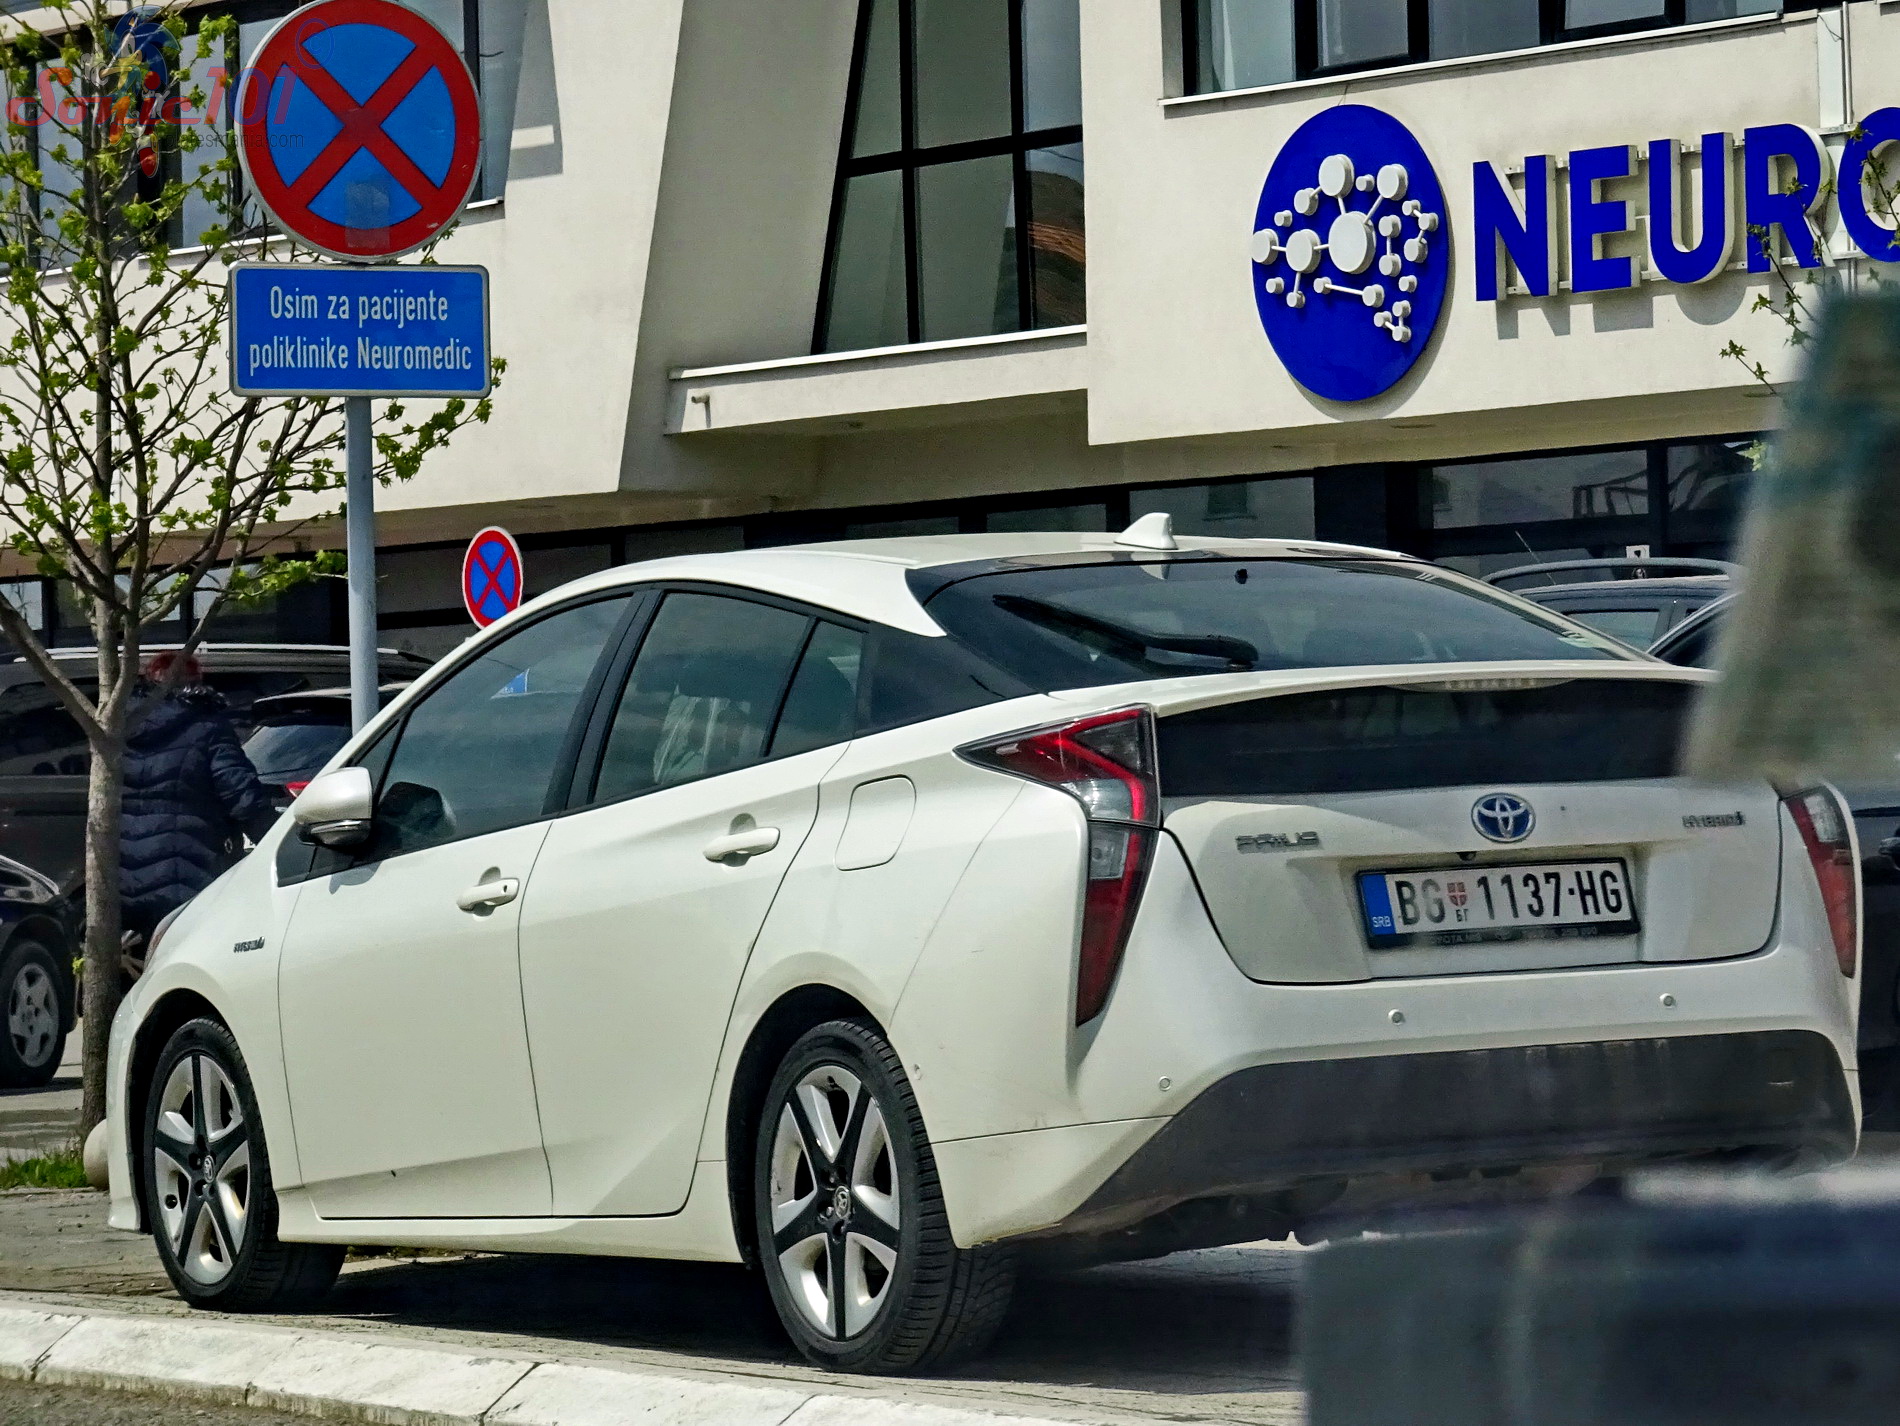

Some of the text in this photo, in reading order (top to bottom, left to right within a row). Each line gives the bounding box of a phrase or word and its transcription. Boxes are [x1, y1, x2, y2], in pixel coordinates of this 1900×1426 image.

[270, 285, 448, 329] Osim za pacijente
[249, 335, 471, 376] poliklinike Neuromedic
[1372, 915, 1392, 928] SRB
[1395, 878, 1446, 926] BG
